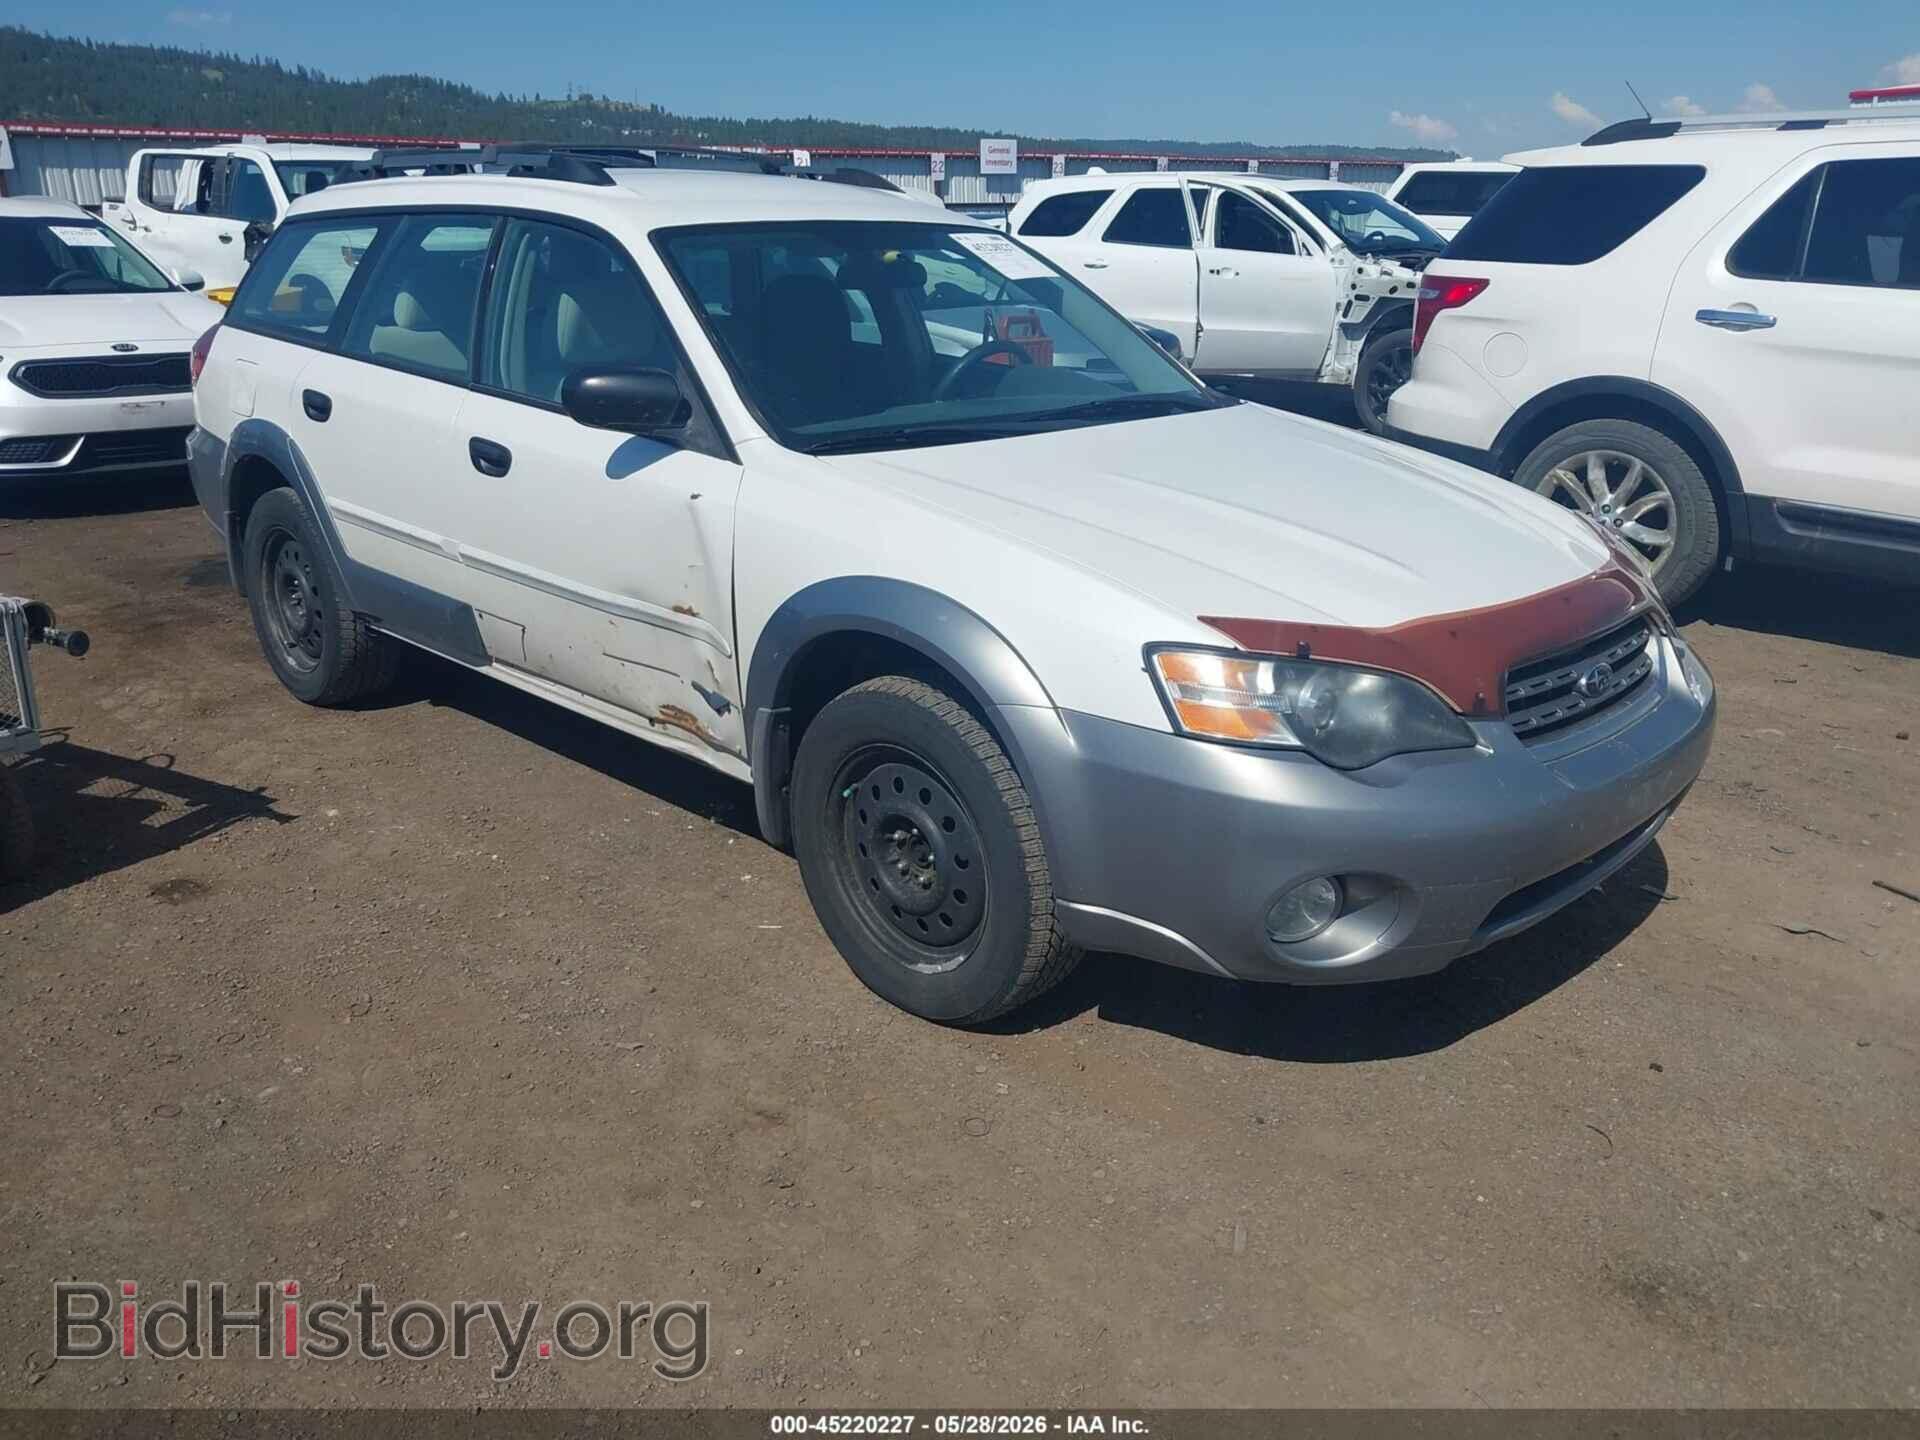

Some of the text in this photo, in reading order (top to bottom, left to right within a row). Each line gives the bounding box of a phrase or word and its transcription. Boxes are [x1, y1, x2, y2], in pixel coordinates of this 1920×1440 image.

[987, 145, 1010, 154] General
[932, 160, 945, 173] 22
[1053, 161, 1064, 174] 23
